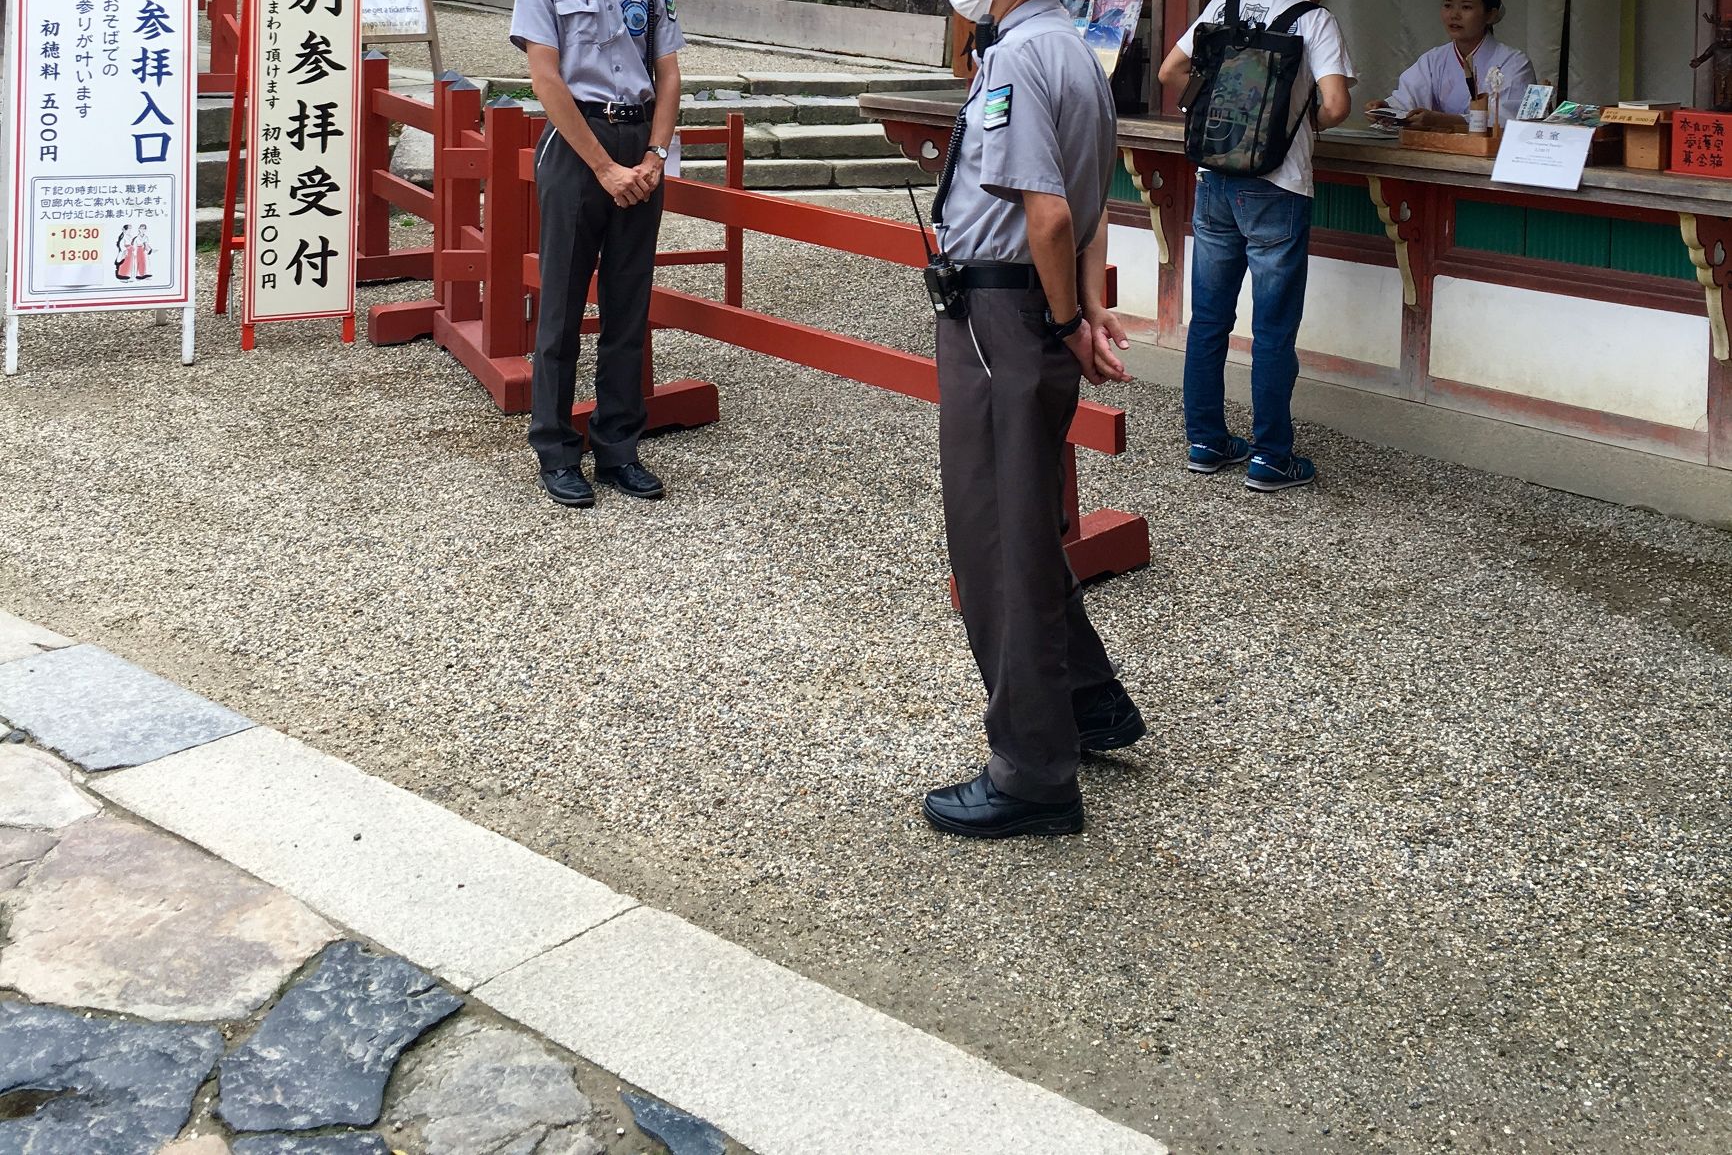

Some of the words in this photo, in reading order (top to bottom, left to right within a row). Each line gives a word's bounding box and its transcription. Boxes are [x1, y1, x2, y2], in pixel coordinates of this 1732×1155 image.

[39, 19, 61, 81] 初穂料
[261, 124, 282, 189] 初穂料
